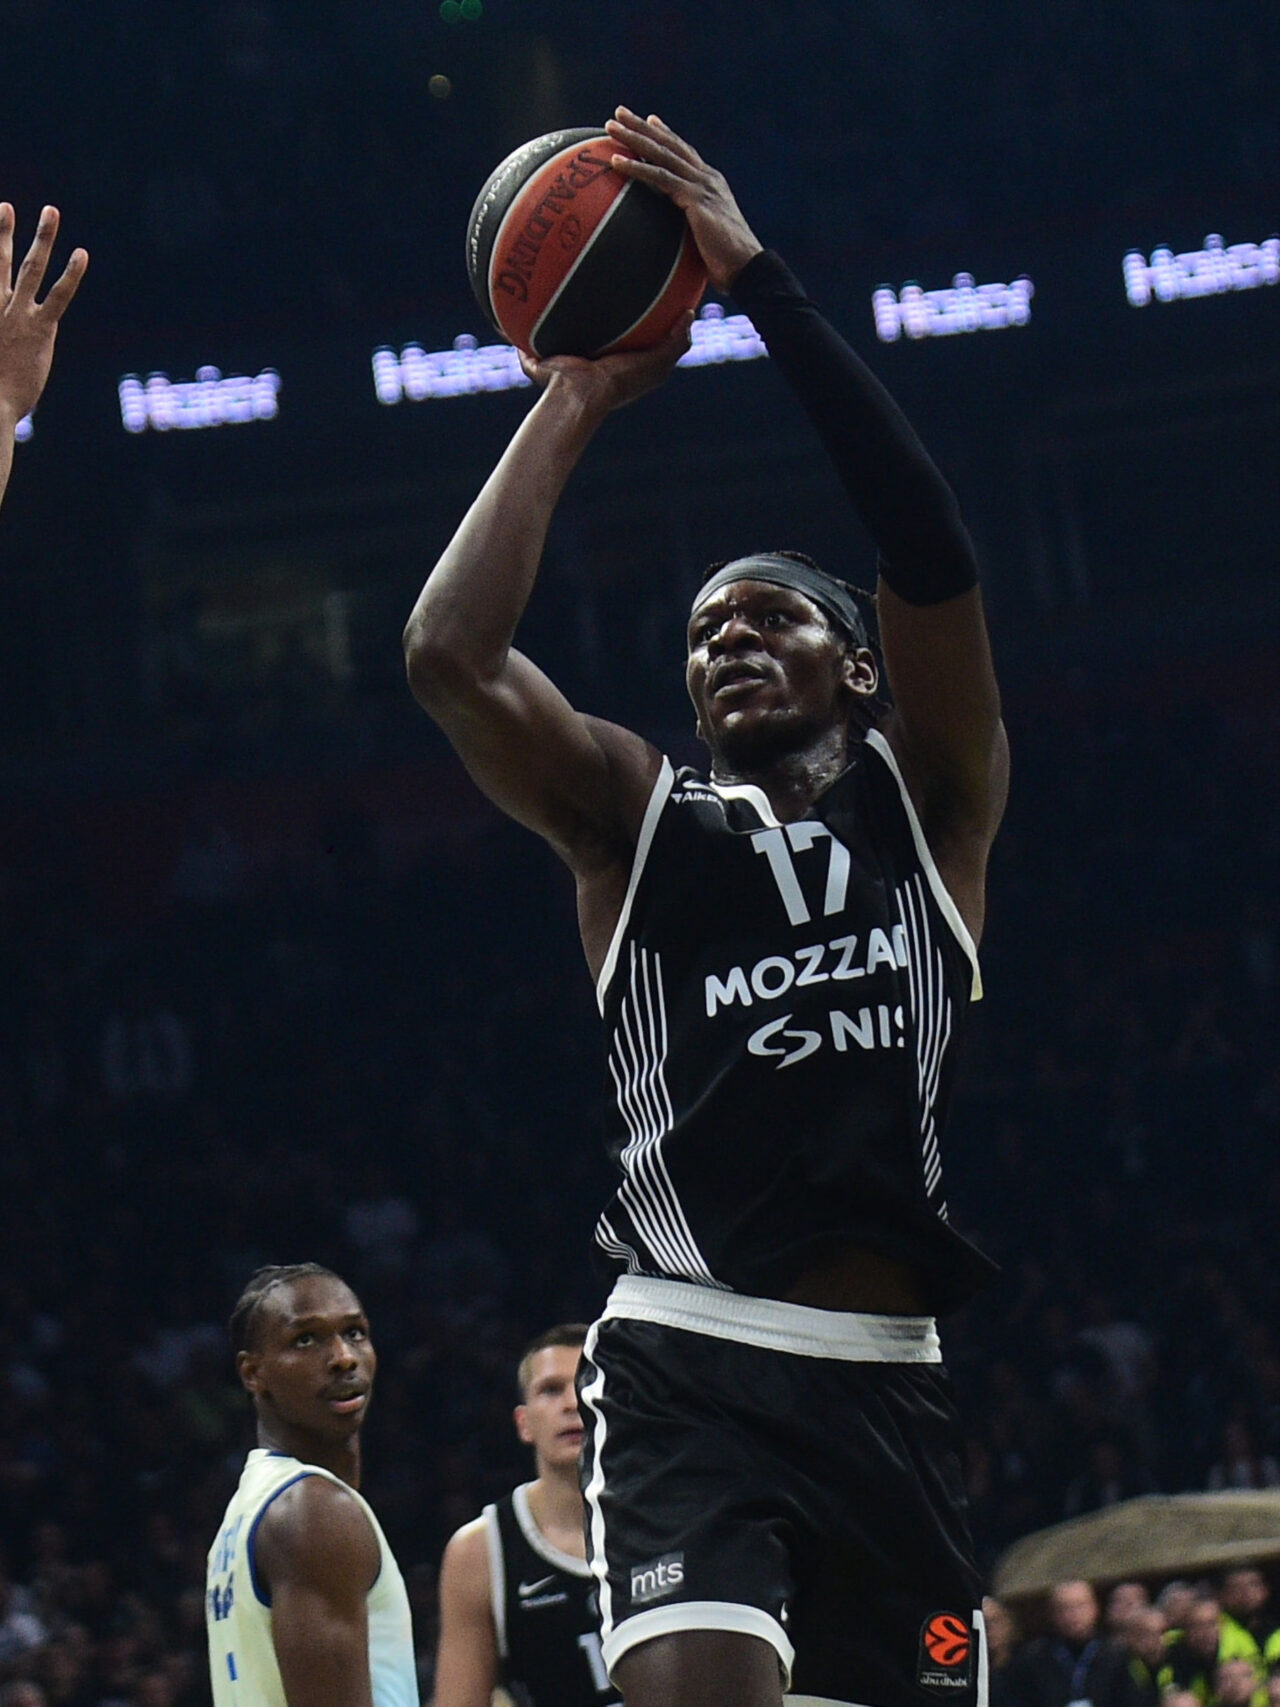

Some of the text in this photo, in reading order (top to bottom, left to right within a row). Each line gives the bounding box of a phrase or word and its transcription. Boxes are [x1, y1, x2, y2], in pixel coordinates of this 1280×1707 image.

[493, 149, 615, 303] SPALDING
[751, 820, 851, 927] 17
[631, 1561, 684, 1597] mts
